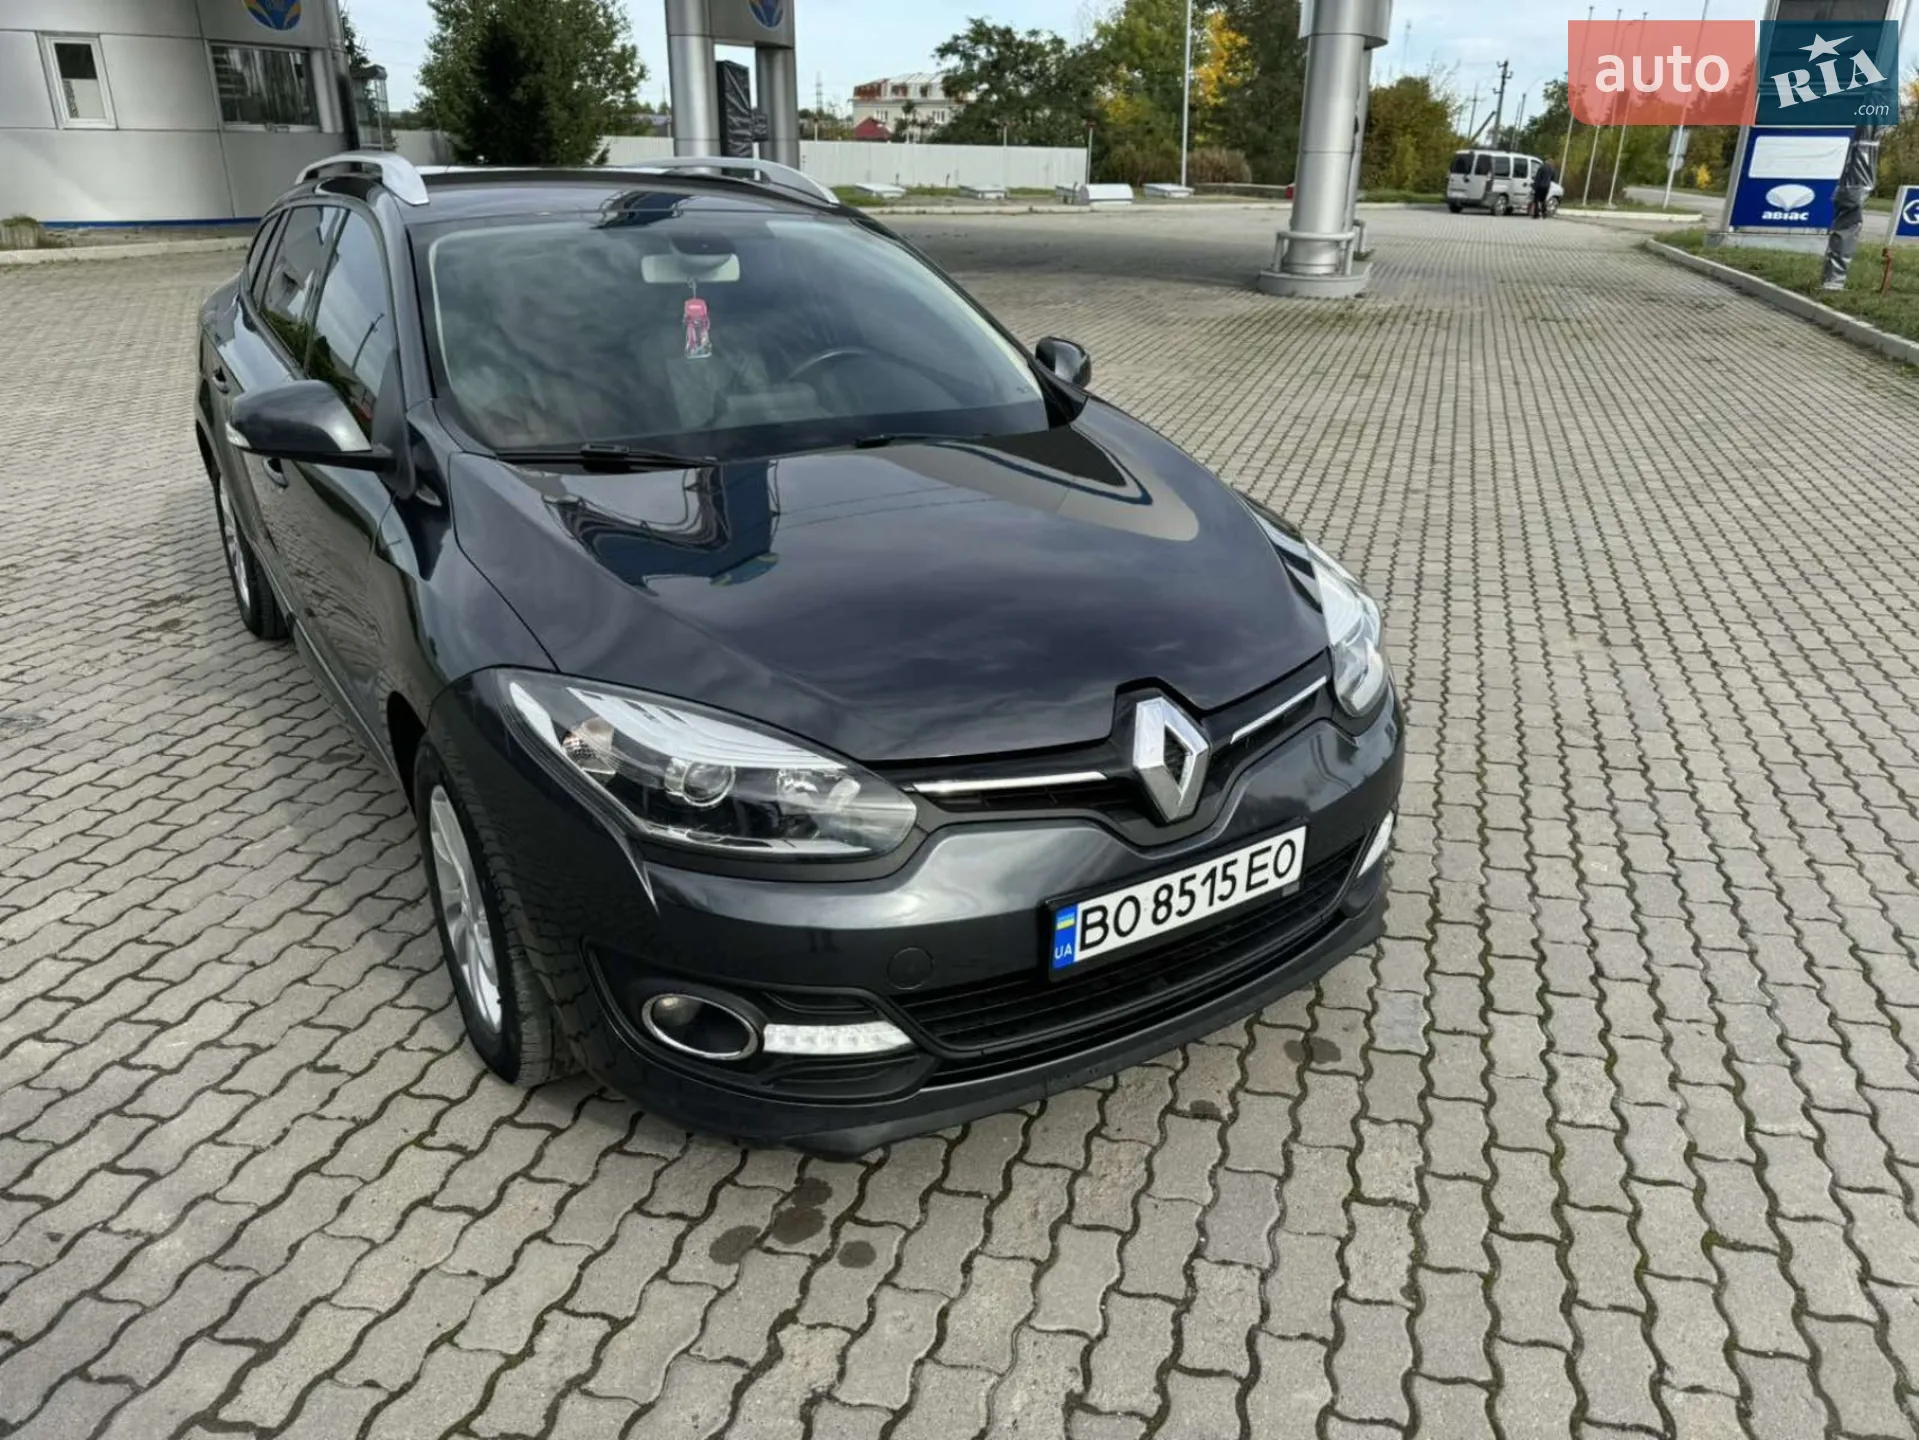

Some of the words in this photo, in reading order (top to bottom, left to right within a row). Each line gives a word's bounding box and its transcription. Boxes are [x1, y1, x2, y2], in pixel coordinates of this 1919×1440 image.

[1079, 895, 1142, 952] BO
[1151, 858, 1238, 926] 8515
[1245, 838, 1297, 893] EO
[1054, 942, 1073, 960] UA
